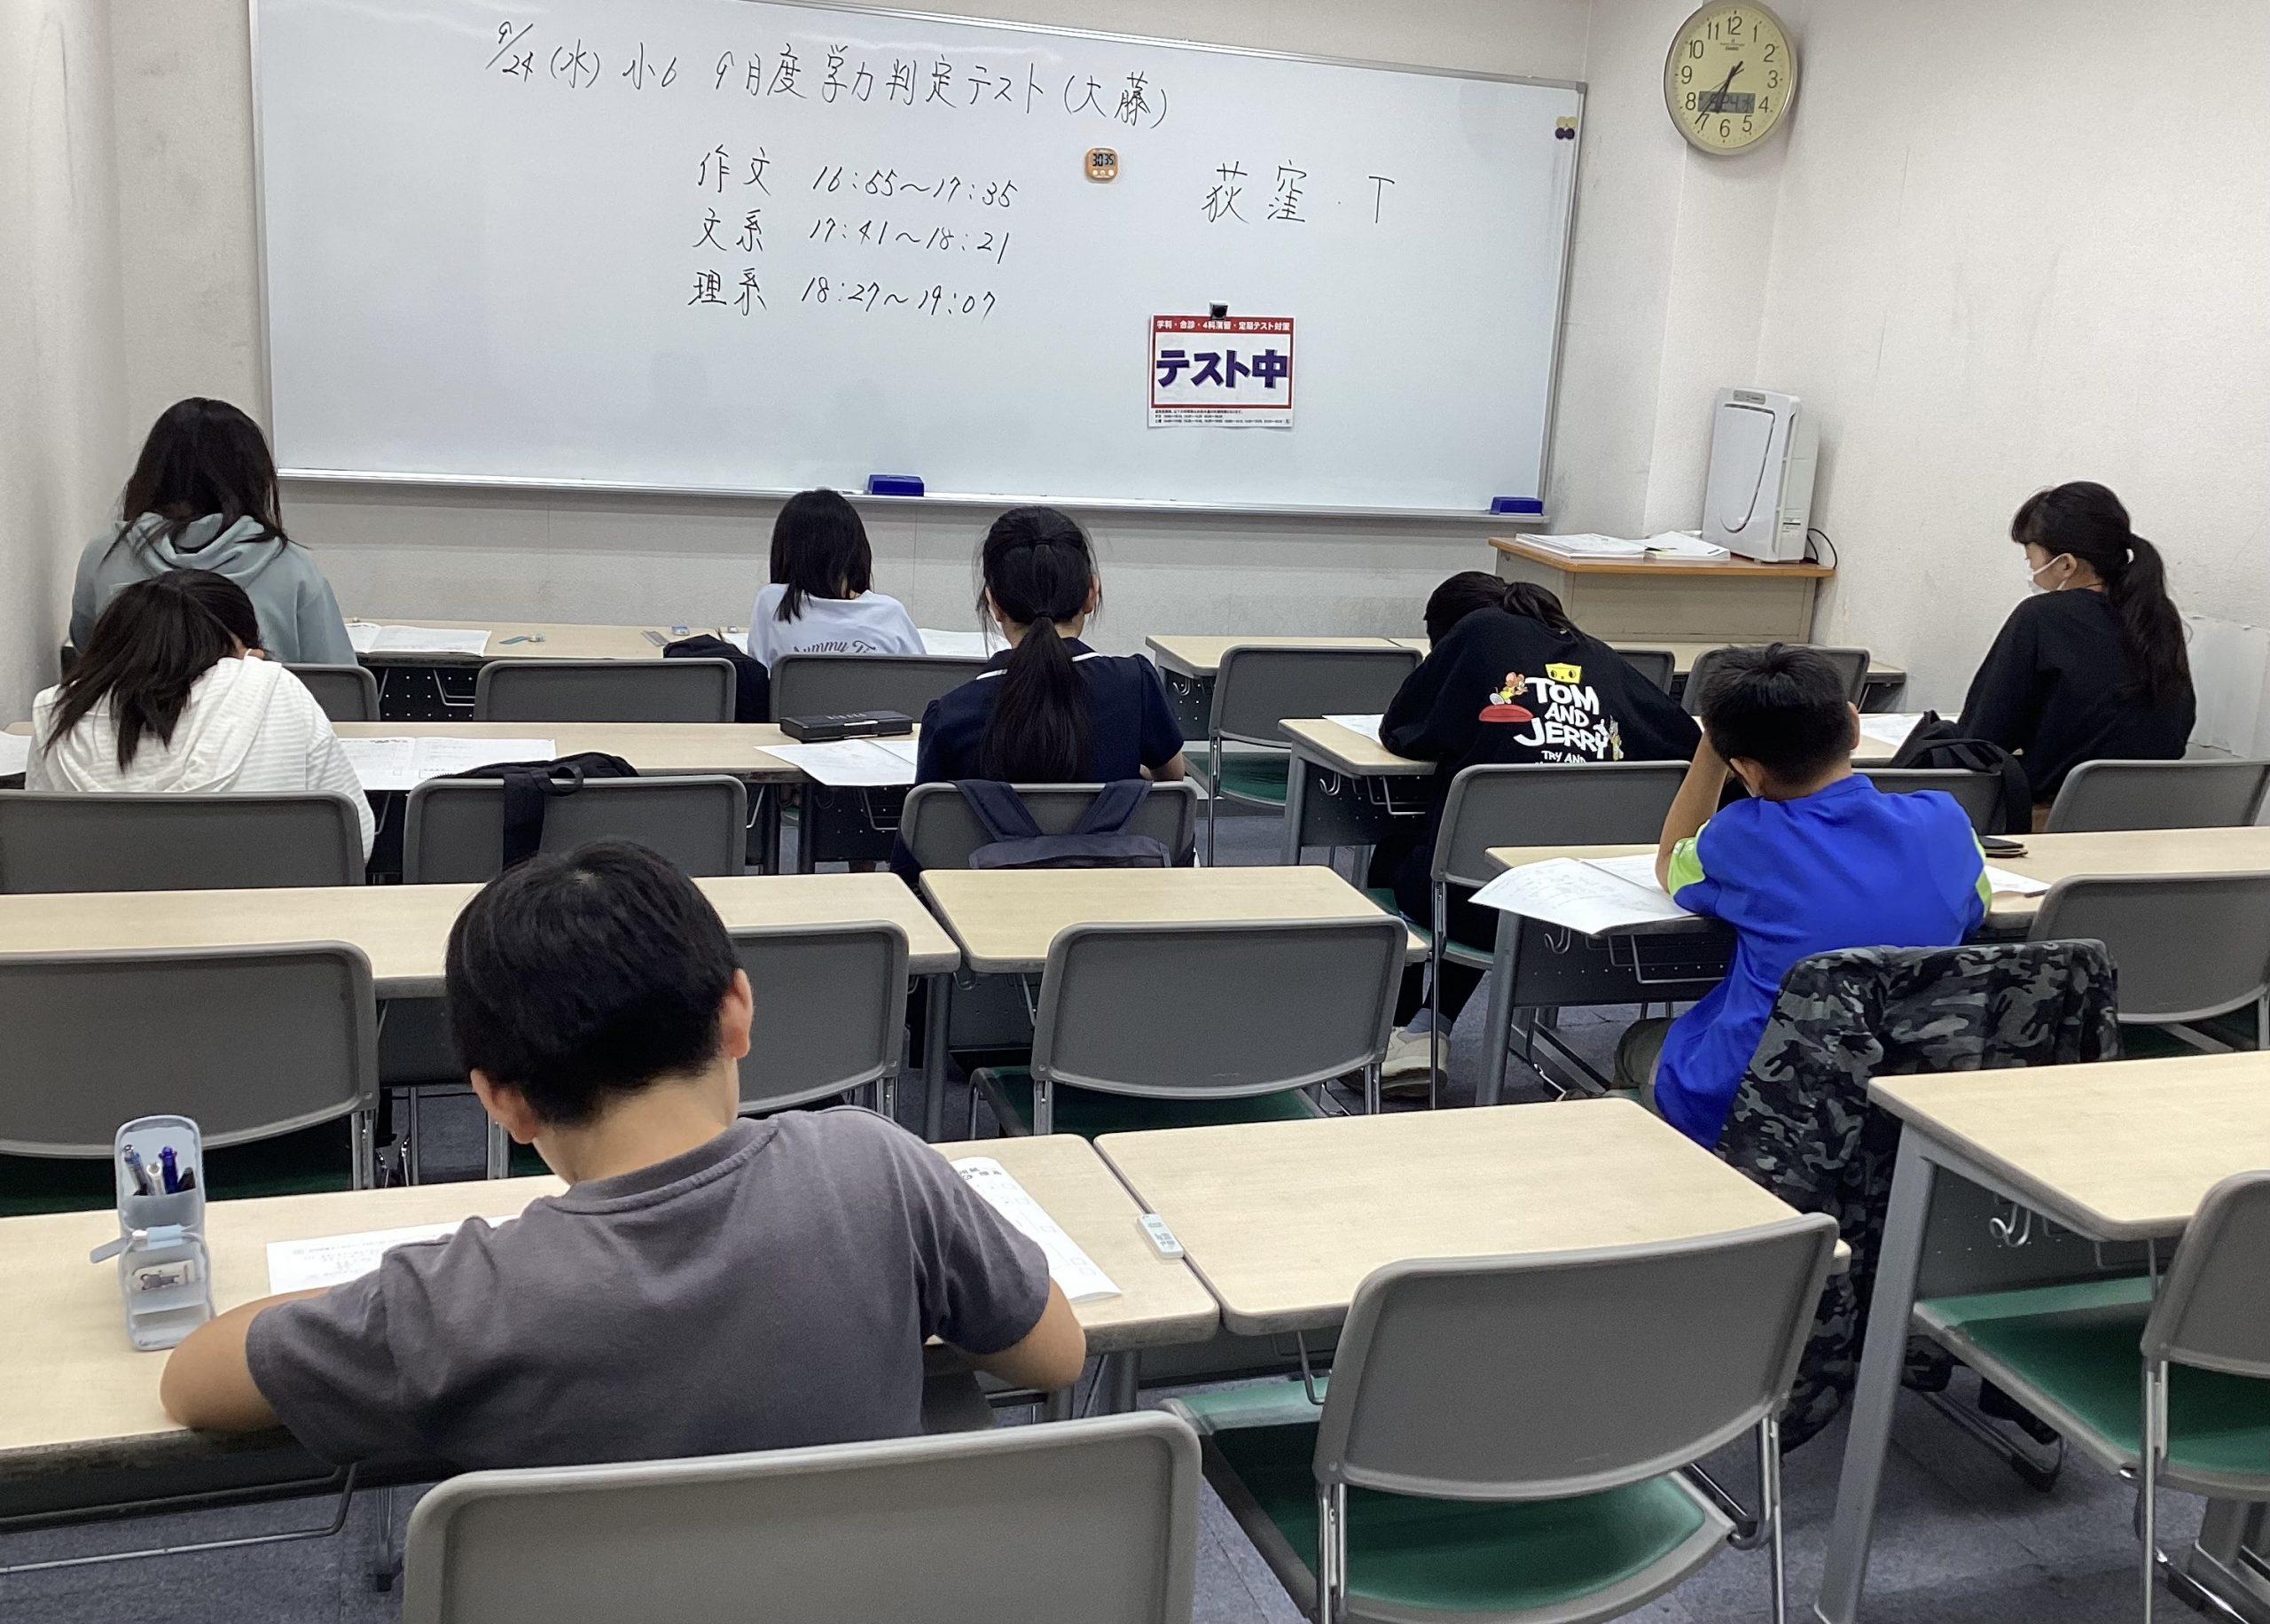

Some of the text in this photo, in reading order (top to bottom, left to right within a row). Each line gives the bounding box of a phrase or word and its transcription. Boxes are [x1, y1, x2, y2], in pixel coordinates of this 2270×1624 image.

[1707, 21, 1719, 41] 11
[1727, 15, 1742, 36] 12
[1753, 23, 1757, 43] 1
[1688, 39, 1704, 59] 10
[1763, 43, 1775, 63] 2
[1680, 65, 1693, 85] 9
[1766, 69, 1779, 90] 3
[1685, 91, 1697, 111] 8
[1757, 96, 1769, 113] 4
[1699, 113, 1710, 131] 7
[1718, 118, 1731, 138] 6
[1742, 114, 1753, 133] 5
[698, 144, 771, 197] 作文
[692, 207, 763, 253] 文系
[687, 267, 768, 316] 理系
[1155, 348, 1291, 390] テスト中
[1524, 676, 1601, 715] TOM
[1544, 702, 1590, 728] AND
[1513, 716, 1609, 760] JERRY
[1541, 750, 1563, 762] TRY
